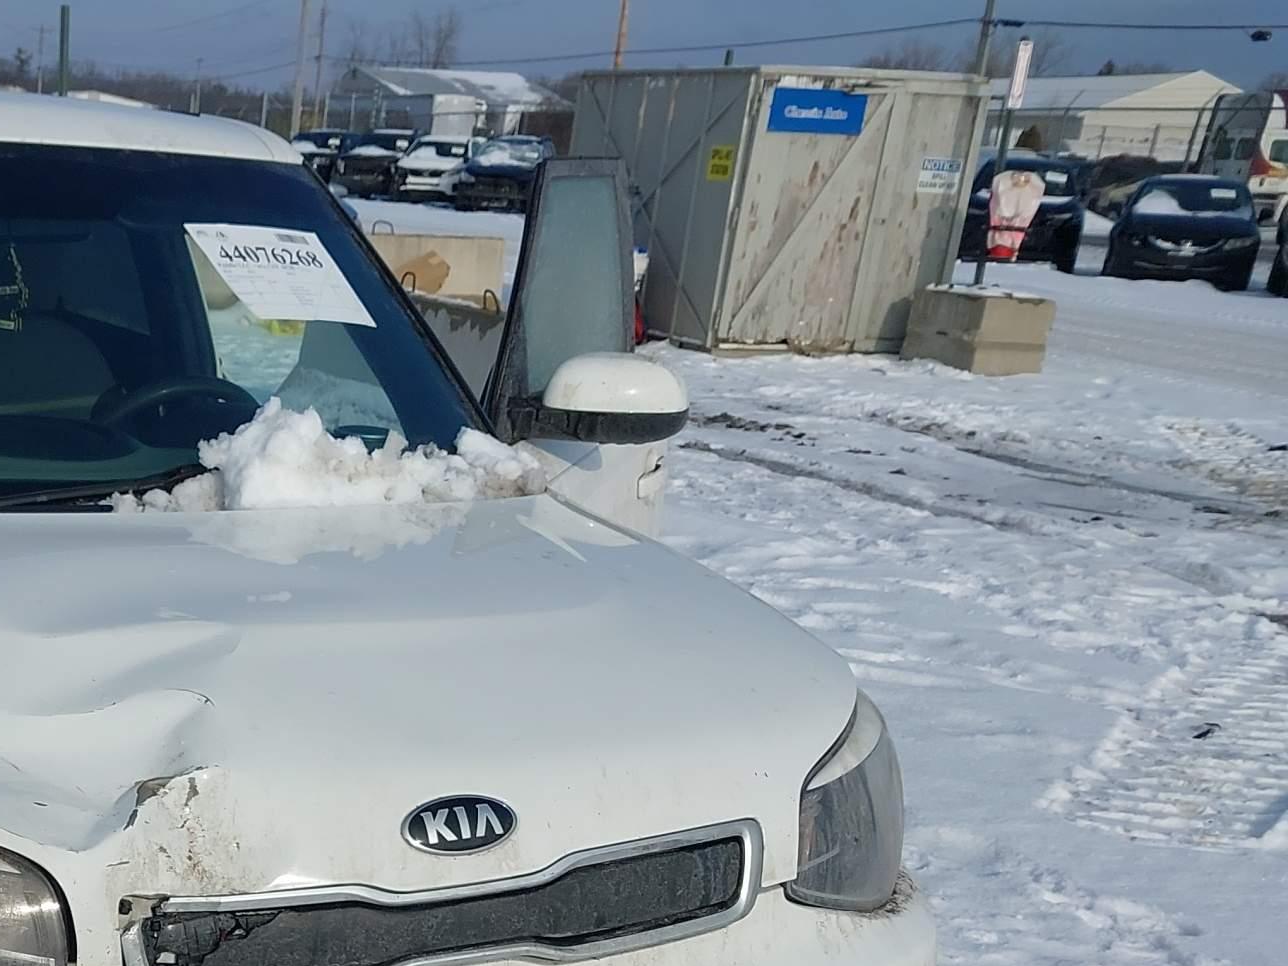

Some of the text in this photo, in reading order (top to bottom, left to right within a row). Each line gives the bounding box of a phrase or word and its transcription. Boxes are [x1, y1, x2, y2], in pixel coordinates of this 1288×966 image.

[923, 159, 960, 171] NOTICE
[219, 245, 324, 269] 44076268
[420, 803, 504, 845] KIA
